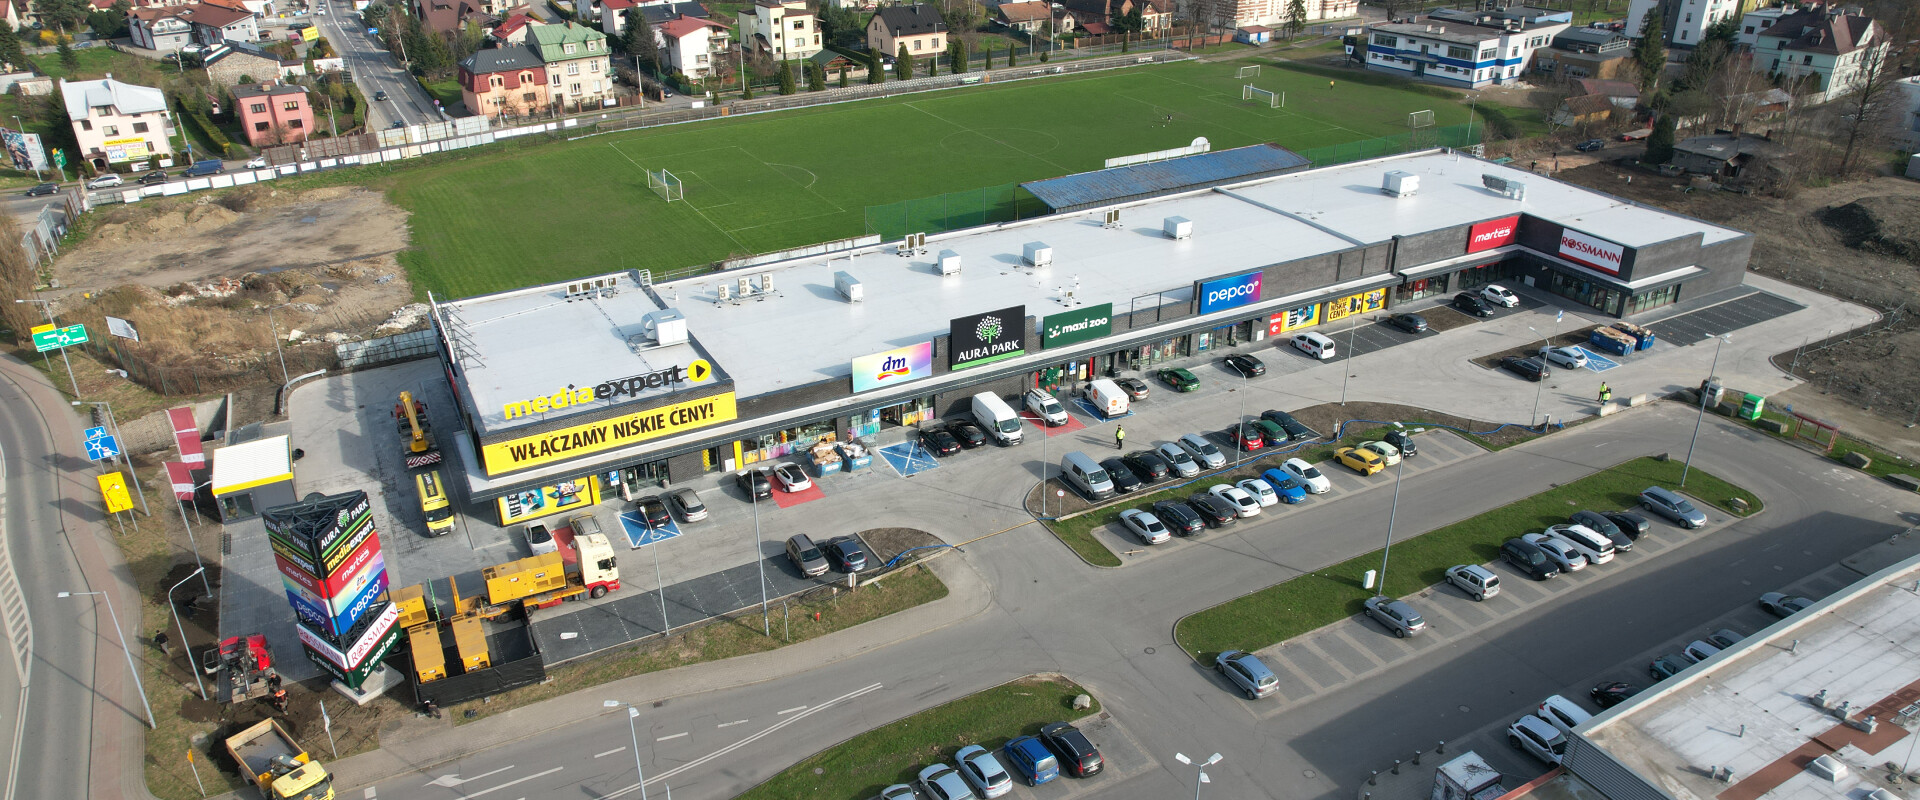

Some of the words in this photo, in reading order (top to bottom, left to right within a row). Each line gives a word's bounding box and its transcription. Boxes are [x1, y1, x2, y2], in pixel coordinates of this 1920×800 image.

[1474, 227, 1512, 243] martes
[1561, 236, 1622, 264] ROSSMANN
[1208, 283, 1254, 306] pepco
[1062, 319, 1088, 335] maxi
[1089, 316, 1108, 328] zoo
[882, 356, 906, 372] dm
[958, 346, 989, 362] AURA
[991, 339, 1020, 355] PARK
[503, 364, 683, 420] mediaexpert
[509, 426, 608, 463] WŁĄCZAMY
[613, 414, 666, 439] NISKIE
[669, 402, 715, 426] CENY!
[321, 527, 340, 550] AURA
[350, 499, 369, 519] PARK
[326, 520, 374, 571] mediaexpert
[341, 548, 369, 581] martes
[350, 582, 380, 621] pepco
[351, 608, 397, 664] ROSSMANN
[370, 639, 386, 666] maxi
[385, 632, 397, 648] zoo
